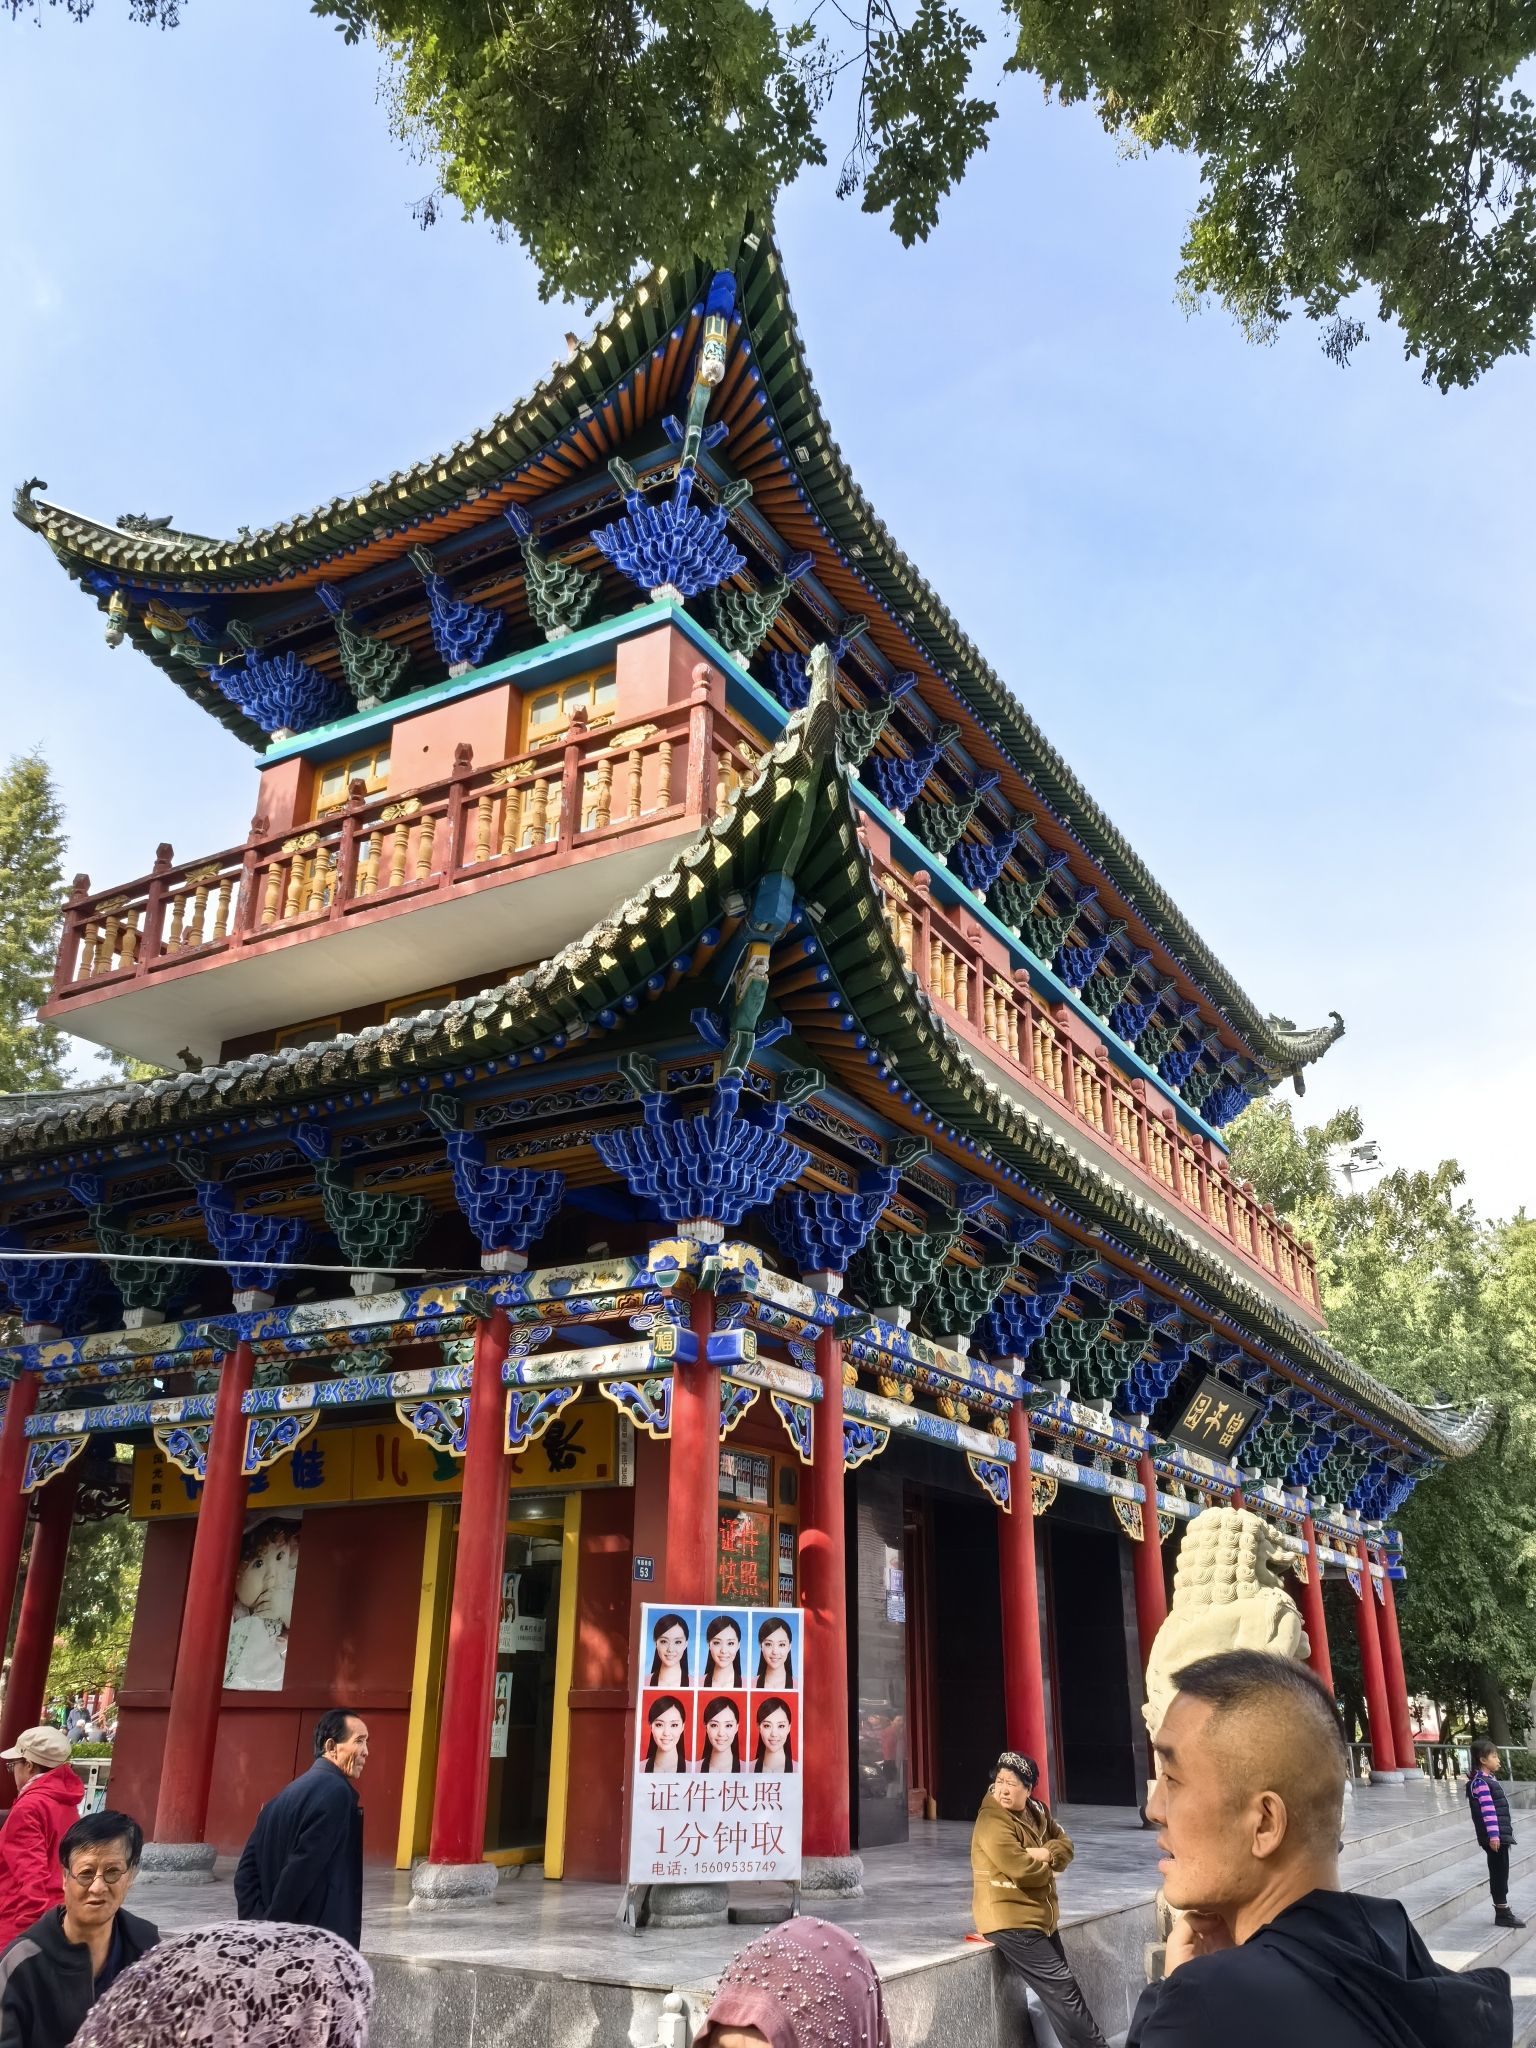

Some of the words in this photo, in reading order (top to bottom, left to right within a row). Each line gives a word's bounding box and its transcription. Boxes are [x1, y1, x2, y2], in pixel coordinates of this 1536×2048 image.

[654, 1331, 673, 1352] 福
[719, 1516, 758, 1558] 证件
[639, 1567, 649, 1578] 53
[719, 1556, 758, 1596] 快照
[647, 1780, 784, 1813] 证件快照
[655, 1821, 787, 1857] 1分钟取
